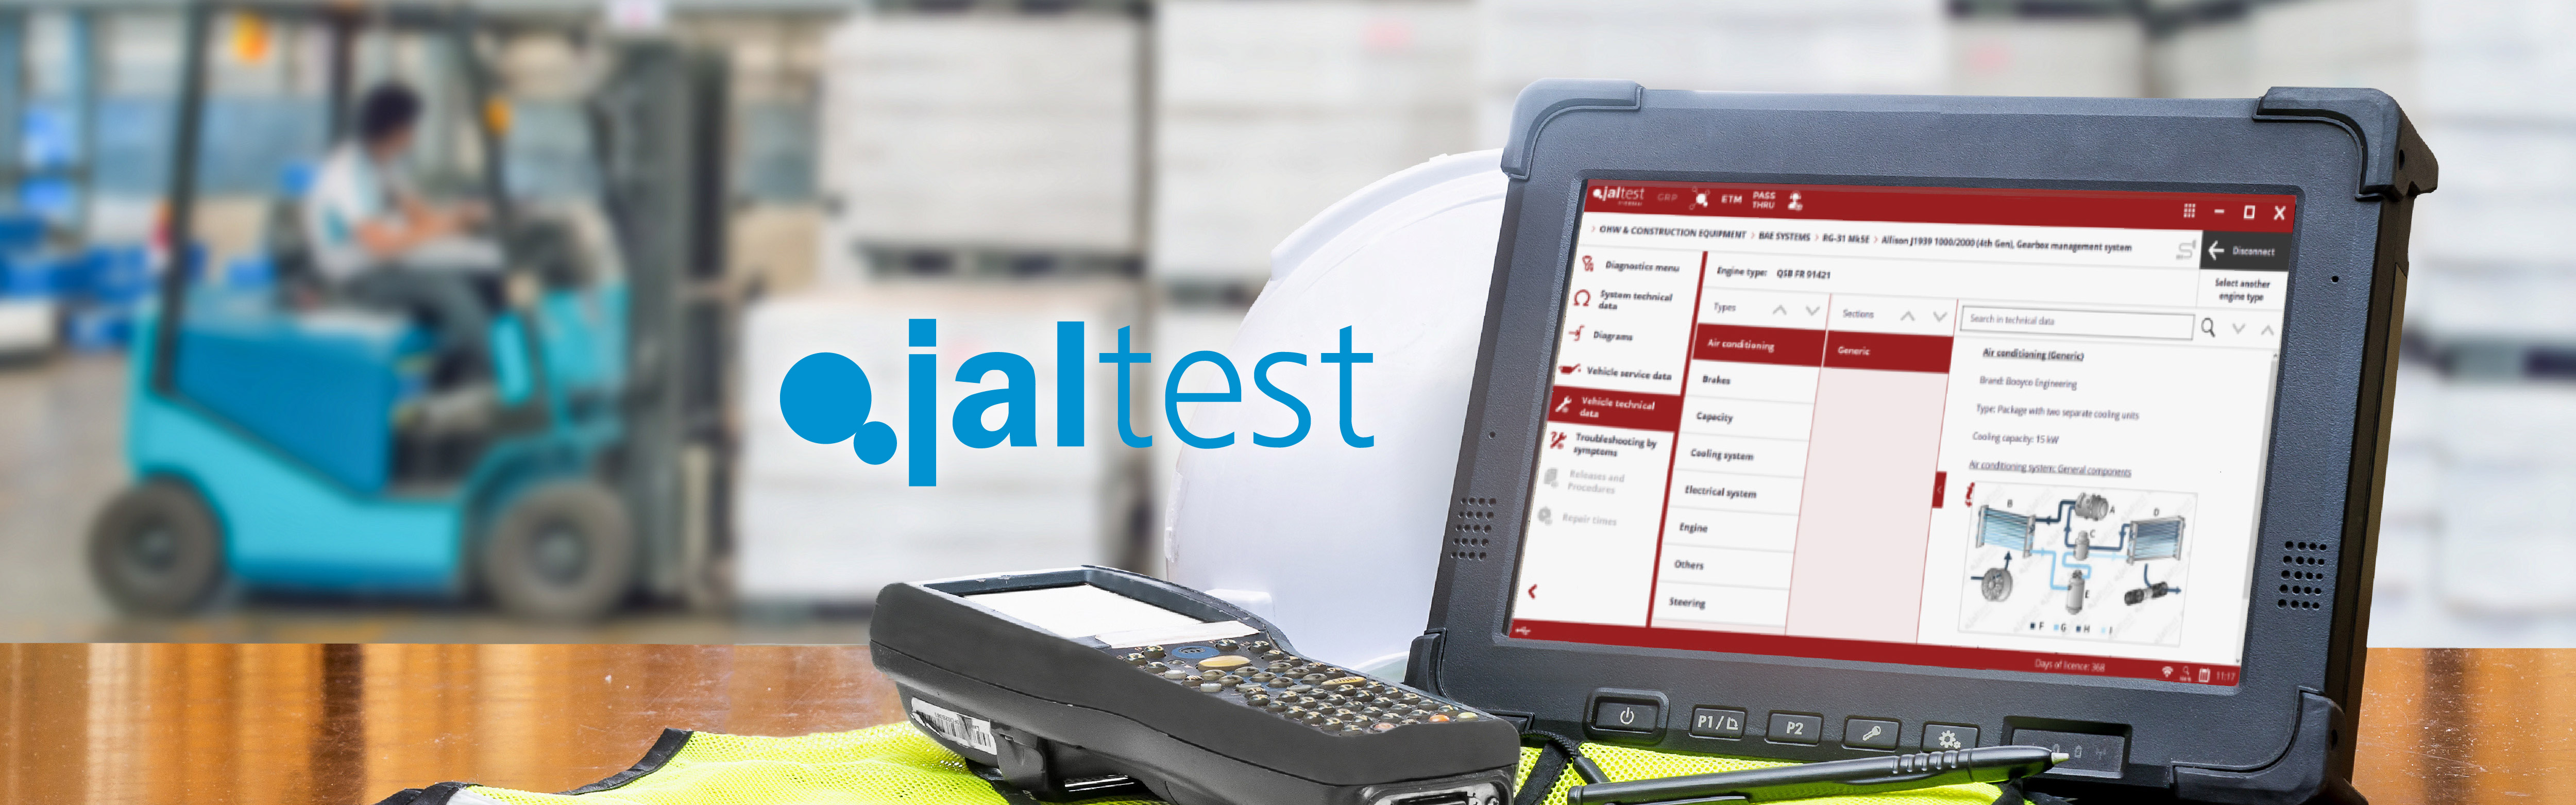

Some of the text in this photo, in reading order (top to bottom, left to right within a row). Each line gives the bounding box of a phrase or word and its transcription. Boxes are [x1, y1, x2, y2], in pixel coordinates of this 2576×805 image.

[1602, 186, 1644, 201] jaltest
[1721, 194, 1742, 204] ETM
[1753, 191, 1776, 199] PASS
[1753, 201, 1775, 209] THRU
[1631, 227, 1697, 237] CONSTRUCTION
[1699, 229, 1747, 239] EQUIPMENT
[1759, 231, 1810, 242] BAE SYSTEMS
[1822, 233, 1845, 242] RG-31
[1910, 237, 1932, 246] J1939
[1935, 237, 1975, 247] 1000/2000
[1976, 238, 1992, 248] (4th
[2016, 239, 2048, 249] Gearbox
[2050, 242, 2102, 253] management
[2105, 244, 2132, 254] system
[2232, 245, 2275, 257] Disconnect
[1605, 260, 1653, 272] Diagnostics
[1717, 266, 1744, 277] Engine
[1747, 268, 1767, 278] type:
[1794, 270, 1805, 278] FR
[1807, 270, 1831, 279] 91421
[2215, 277, 2270, 289] Select another
[1600, 289, 1673, 302] System technical
[2219, 291, 2264, 304] engine type
[1599, 300, 1618, 310] data
[1714, 301, 1736, 313] Types
[1843, 309, 1874, 318] Sections
[1970, 313, 2055, 326] Search in technical data
[1594, 330, 1633, 342] Diagrams
[1707, 338, 1775, 354] Air conditioning
[1838, 346, 1870, 356] Generic
[1982, 347, 2084, 362] Air conditioning (Generic)
[1587, 365, 1672, 380] Vehicle service data
[1702, 374, 1731, 385] Brakes
[1979, 376, 2004, 385] Brand:
[2035, 378, 2078, 391] Engineering
[1582, 396, 1655, 410] Vehicle technical
[1580, 408, 1599, 418] data
[1697, 411, 1734, 425] Capacity
[1976, 403, 2139, 422] Type: Package with two separate cooling units
[1576, 432, 1657, 450] Troubleshooting by
[1972, 431, 2060, 445] Cooling capacity: 15 kW
[1573, 446, 1618, 457] symptoms
[1690, 448, 1754, 462] Cooling system
[1969, 460, 1980, 470] Air
[1981, 461, 2027, 474] conditioning
[2058, 464, 2086, 475] General
[2088, 467, 2132, 478] components
[1570, 469, 1625, 482] Releases and
[1568, 482, 1615, 494] Procedures
[1685, 485, 1757, 499] Electrical system
[2007, 499, 2013, 508] B
[2109, 506, 2115, 514] A
[2153, 508, 2160, 517] D
[1563, 512, 1617, 526] Repair times
[1680, 522, 1708, 534] Engine
[2090, 529, 2096, 539] C
[1674, 559, 1704, 570] Others
[1669, 597, 1706, 610] Steering
[2039, 621, 2044, 630] F
[2061, 623, 2066, 632] G
[2083, 624, 2090, 633] H
[2035, 658, 2053, 670] Days
[2054, 659, 2062, 669] of
[1786, 721, 1804, 735] P2
